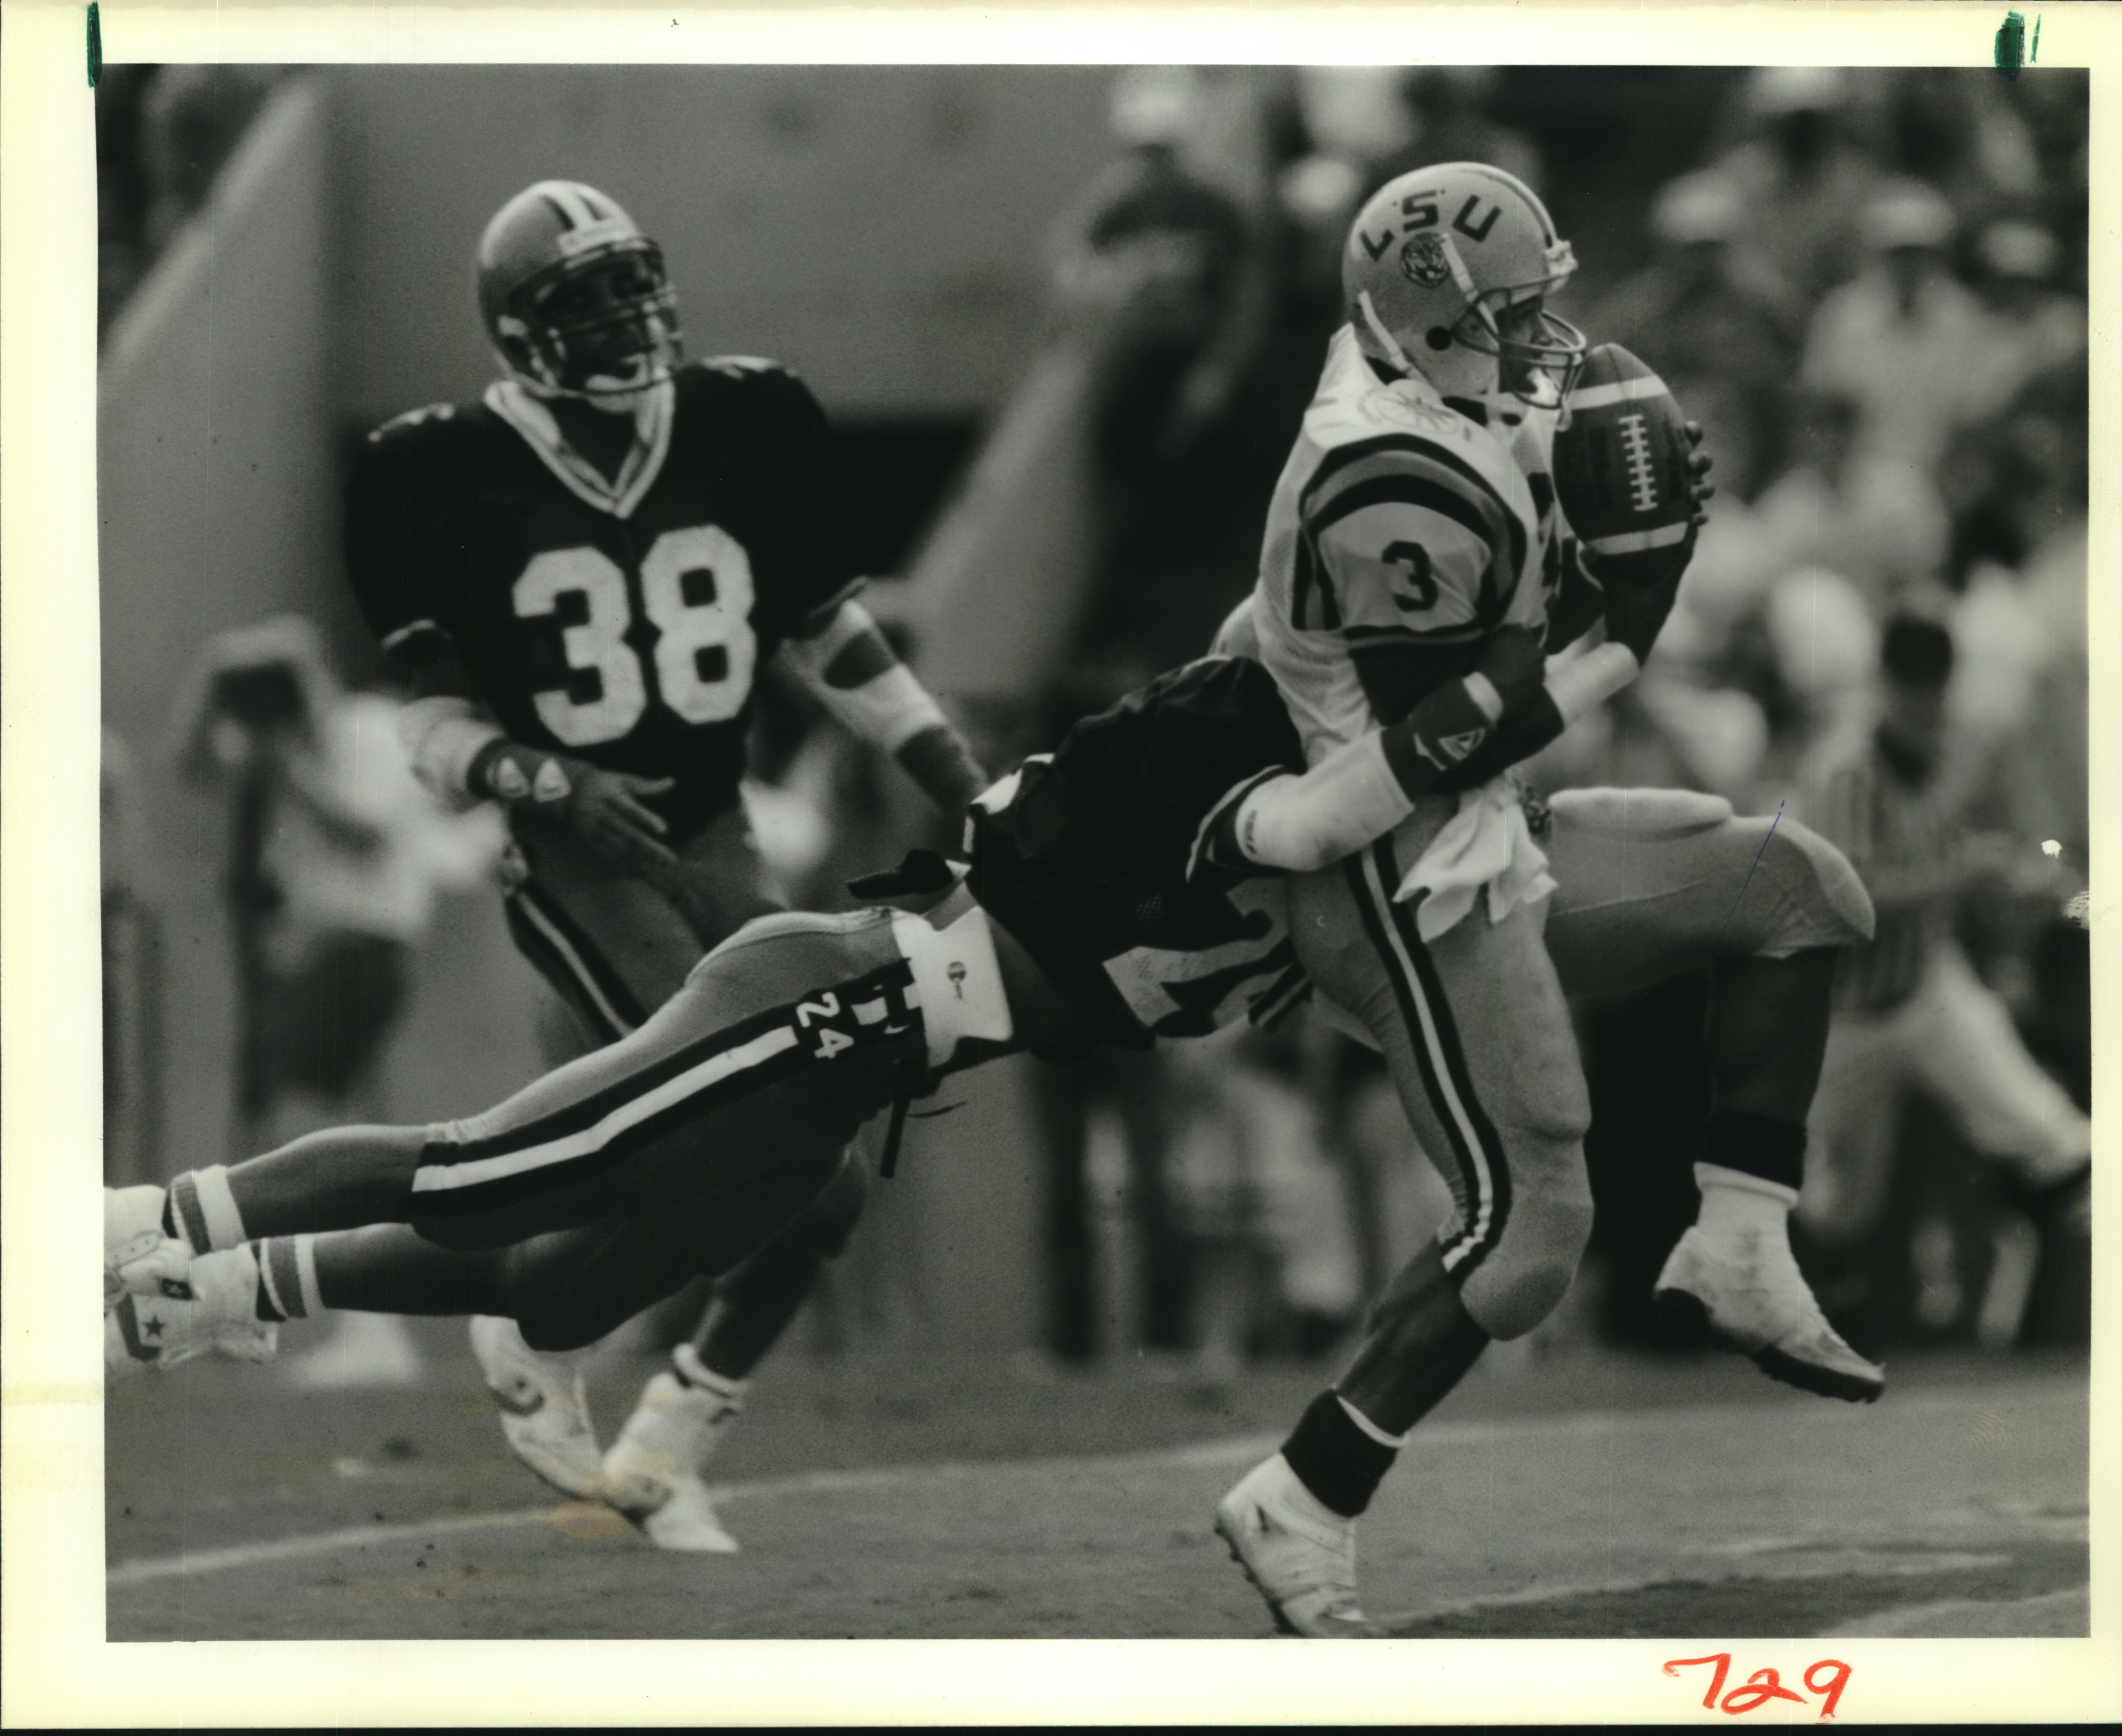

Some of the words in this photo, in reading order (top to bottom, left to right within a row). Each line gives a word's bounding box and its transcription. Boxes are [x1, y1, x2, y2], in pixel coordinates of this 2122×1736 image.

[1360, 189, 1501, 262] LSU
[1382, 540, 1438, 612] 3
[512, 525, 756, 746] 38
[796, 991, 854, 1059] 24
[1661, 1652, 1853, 1719] 729
